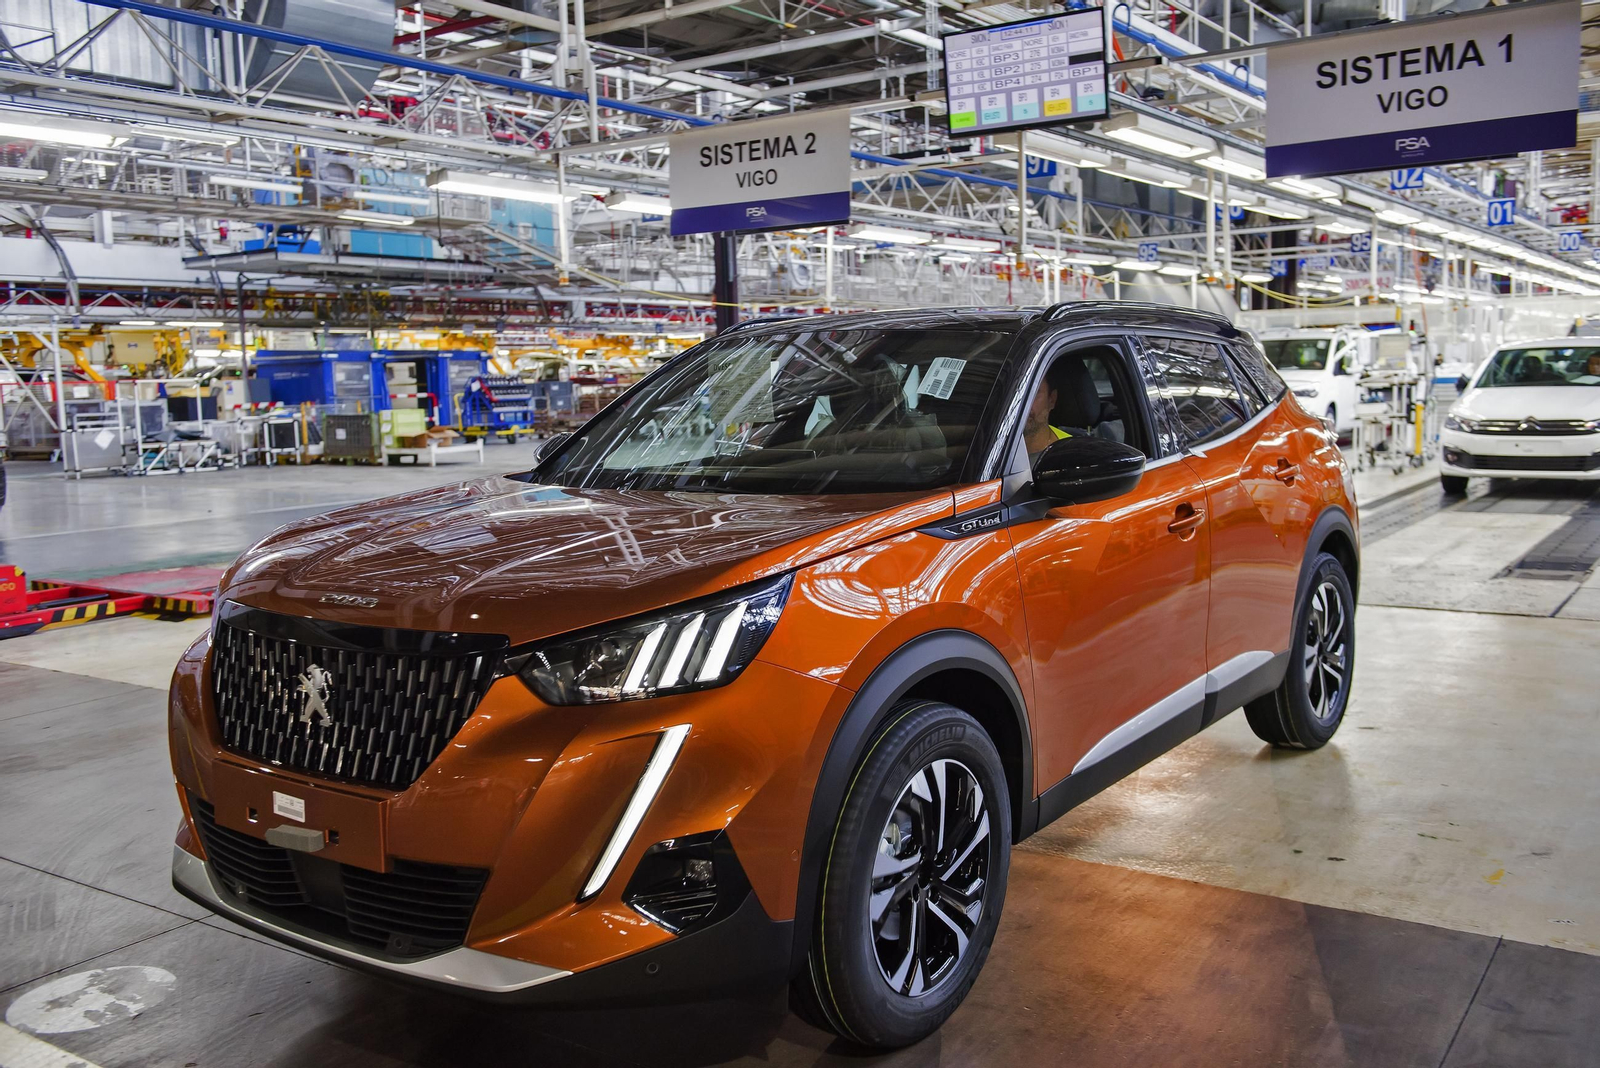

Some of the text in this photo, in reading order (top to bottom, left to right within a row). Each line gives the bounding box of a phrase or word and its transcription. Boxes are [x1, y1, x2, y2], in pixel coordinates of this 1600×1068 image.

[1004, 27, 1033, 37] 12:44:11
[993, 54, 1020, 64] BP3
[1316, 33, 1513, 89] SISTEMA 1
[994, 66, 1021, 76] BP2
[1072, 67, 1099, 77] BP1
[995, 78, 1021, 88] BP4
[1376, 85, 1448, 114] VIGO
[700, 132, 816, 168] SISTEMA 2
[1395, 136, 1431, 151] PSA
[736, 168, 778, 188] VIGO
[1393, 168, 1423, 189] 02
[746, 206, 767, 217] PSA
[1489, 202, 1514, 224] 01
[1352, 234, 1371, 251] 95
[1560, 233, 1580, 250] 00
[1139, 244, 1157, 262] 95
[1272, 261, 1287, 276] 94
[961, 519, 978, 532] GT
[319, 593, 379, 608] 2008
[908, 726, 966, 767] MICHELIN
